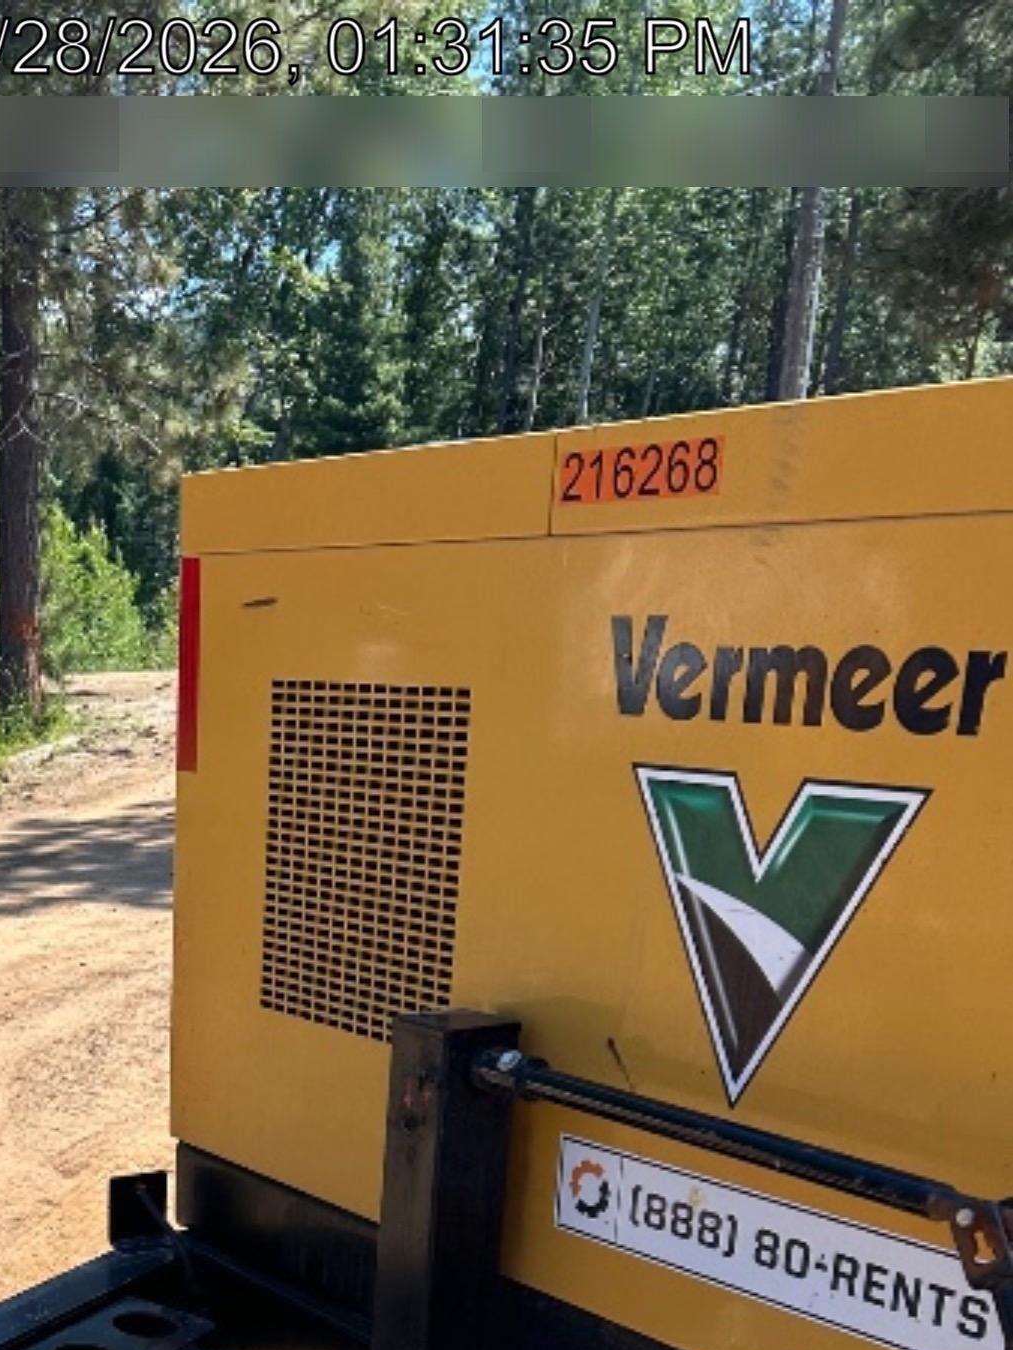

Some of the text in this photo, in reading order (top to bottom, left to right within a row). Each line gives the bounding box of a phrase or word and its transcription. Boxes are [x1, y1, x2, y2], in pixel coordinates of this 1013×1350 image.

[561, 437, 719, 502] 216268
[610, 614, 1009, 737] Vermeer
[630, 1184, 989, 1340] (888) 80-RENTS
